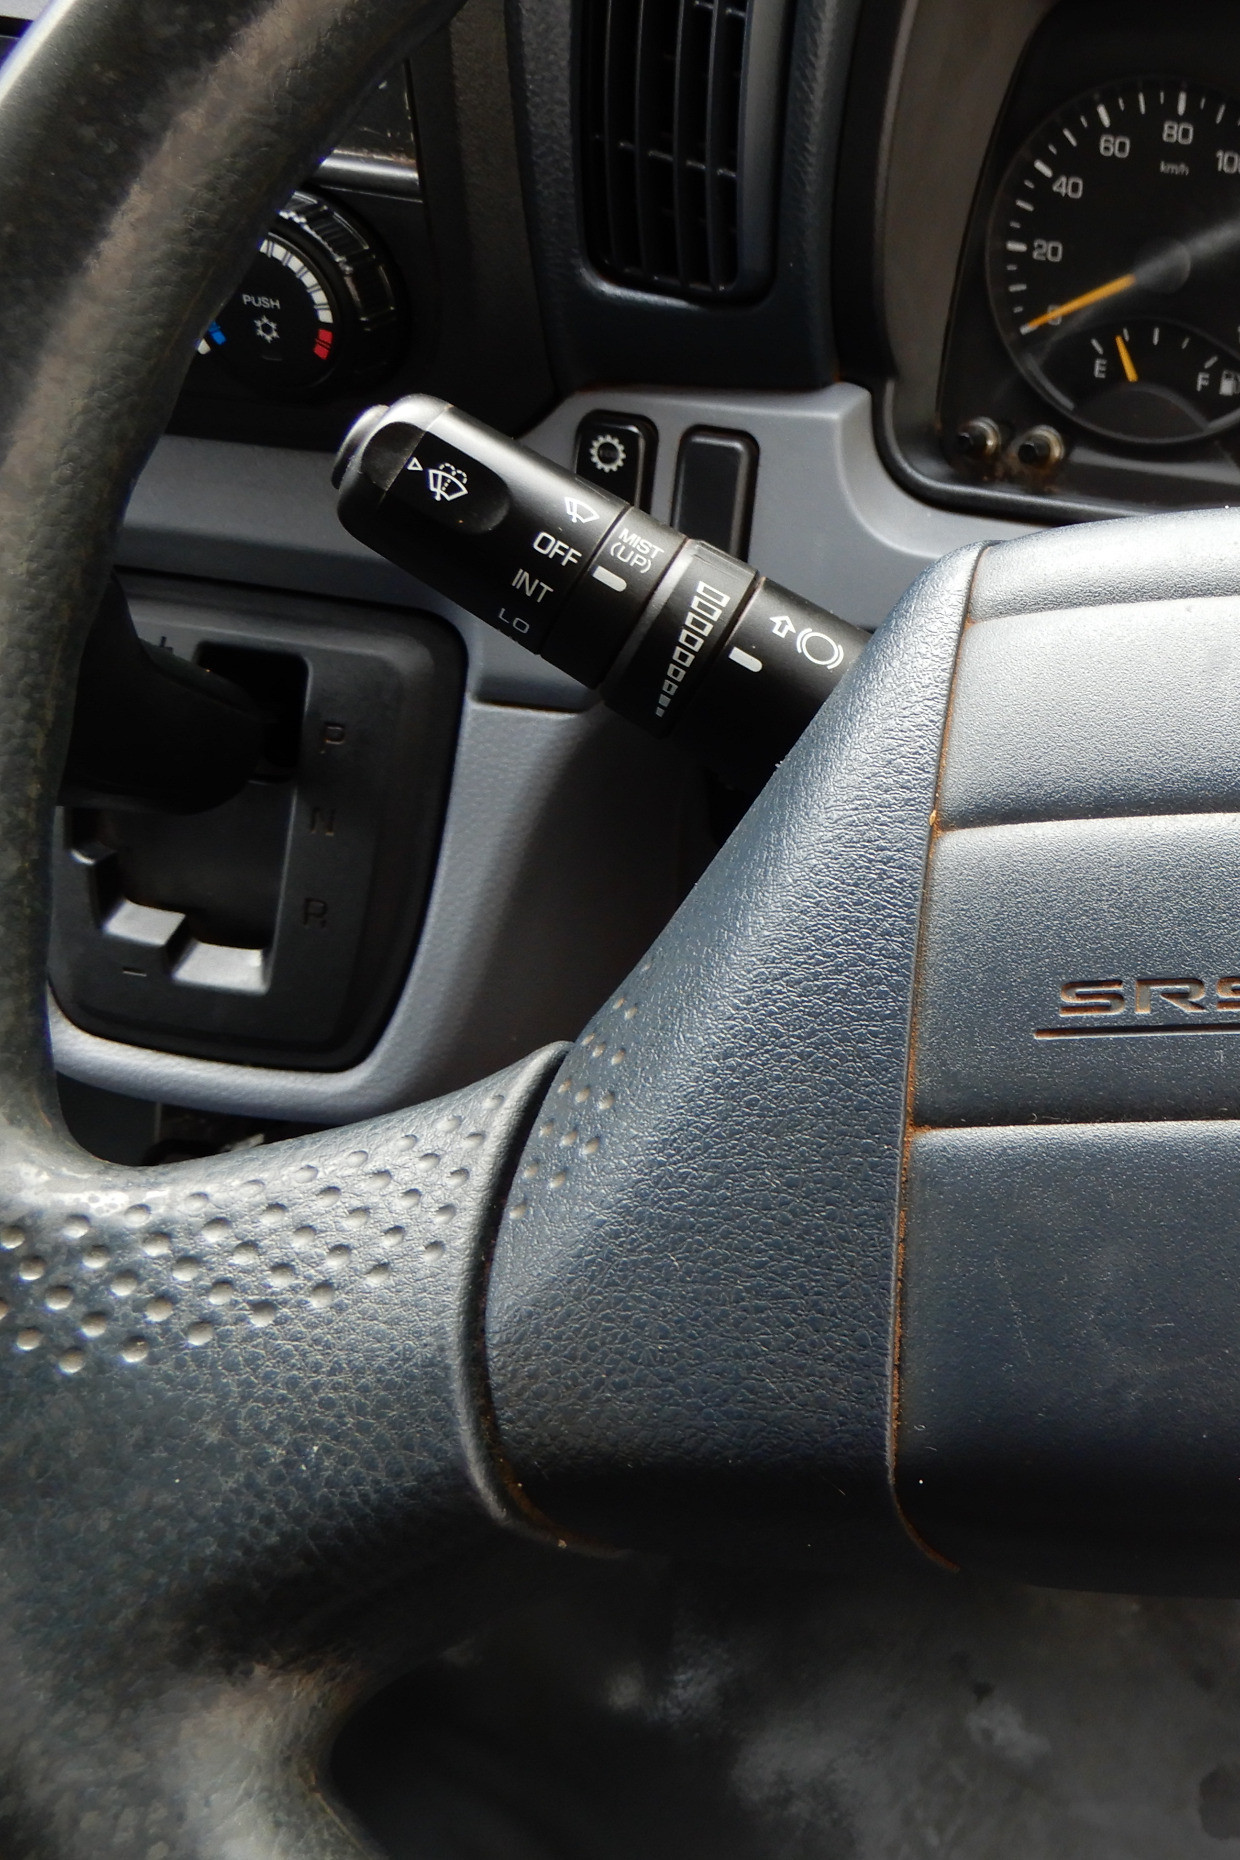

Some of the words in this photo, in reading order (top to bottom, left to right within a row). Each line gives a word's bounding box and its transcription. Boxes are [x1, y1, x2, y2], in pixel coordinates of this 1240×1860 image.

[1162, 121, 1194, 145] 80
[1099, 135, 1131, 159] 60
[1160, 161, 1190, 176] km/h
[1052, 176, 1083, 199] 40
[1032, 239, 1063, 262] 20
[242, 294, 281, 310] PUSH
[1094, 358, 1107, 379] E
[1196, 372, 1210, 392] F
[532, 532, 582, 567] OFF
[617, 528, 665, 560] MIST
[610, 541, 653, 575] (UP)
[511, 568, 554, 603] INT
[499, 608, 530, 634] LO
[320, 722, 346, 754] P
[310, 807, 337, 837] N
[303, 897, 329, 929] R
